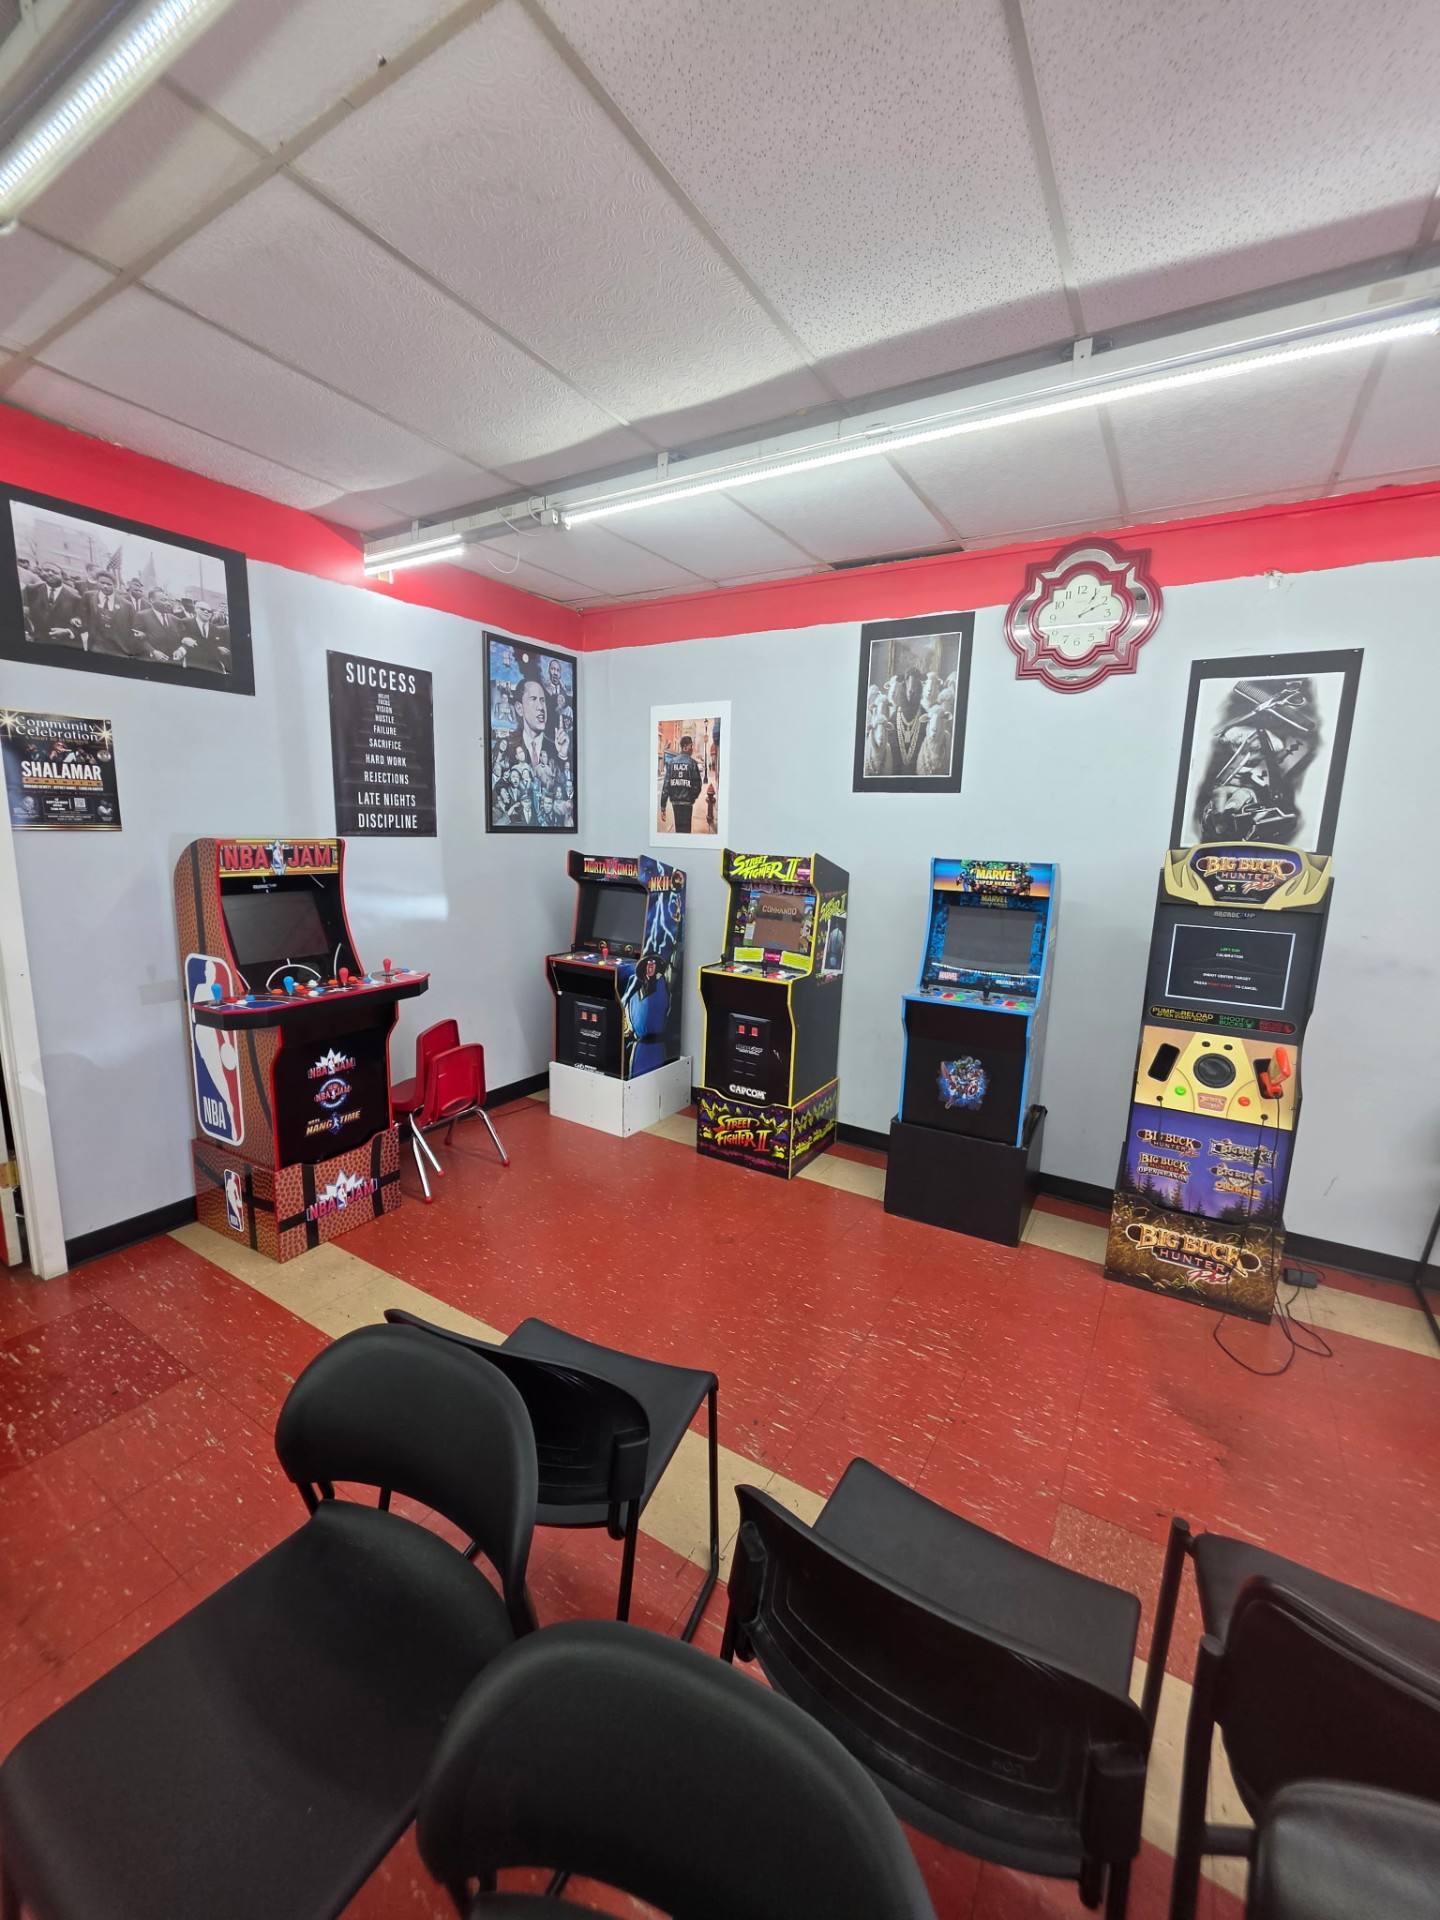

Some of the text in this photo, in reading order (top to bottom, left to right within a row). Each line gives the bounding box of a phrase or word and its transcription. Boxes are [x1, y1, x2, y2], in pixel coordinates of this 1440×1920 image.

[1066, 591, 1072, 599] 11
[1078, 586, 1088, 594] 12
[1055, 601, 1064, 609] 10
[1102, 596, 1108, 605] 2
[1050, 614, 1056, 623] 9
[1104, 609, 1111, 618] 3
[1063, 635, 1069, 644] 7
[1073, 637, 1080, 646] 6
[1088, 633, 1094, 641] 5
[346, 662, 416, 694] SUCCESS
[376, 705, 392, 714] VISION
[16, 715, 96, 732] Community
[375, 714, 394, 724] HUSTLE
[16, 726, 99, 741] Celebration
[373, 725, 397, 735] FAILURE
[369, 738, 402, 750] SACRIFICE
[365, 754, 406, 767] HARD WORK
[21, 760, 102, 780] SHALAMAR
[364, 771, 409, 785] REJECTIONS
[670, 779, 691, 787] BEAUTIFUL
[358, 792, 416, 806] LATE NIGHTS
[358, 813, 418, 829] DISCIPLINE
[223, 844, 332, 870] NBA JAM
[730, 855, 768, 876] STREET
[738, 858, 802, 882] FIGHTER II
[1206, 857, 1284, 878] BIG BUCK
[976, 869, 1016, 880] MARVEL
[762, 905, 797, 915] COMMANDO
[938, 971, 958, 981] MARVEL
[1181, 1010, 1214, 1020] RELOAD
[310, 1057, 354, 1078] NBA JAM
[316, 1085, 350, 1102] NBA JAM
[729, 1084, 766, 1100] CAPCOM
[203, 1096, 226, 1130] NBA
[306, 1120, 332, 1136] HANG
[340, 1111, 361, 1124] TIME
[713, 1115, 760, 1132] STREET
[715, 1130, 773, 1152] FIGHTER II
[1154, 1141, 1186, 1151] HUNTER
[1165, 1134, 1195, 1150] BUCK
[1221, 1145, 1238, 1153] BIG
[1141, 1153, 1187, 1171] BIG BUCK
[1138, 1167, 1157, 1175] OPEN
[1217, 1168, 1234, 1177] BIG
[310, 1178, 374, 1220] NBA JAM
[1138, 1224, 1247, 1276] BIG BUCK
[1160, 1249, 1225, 1271] HUNTER
